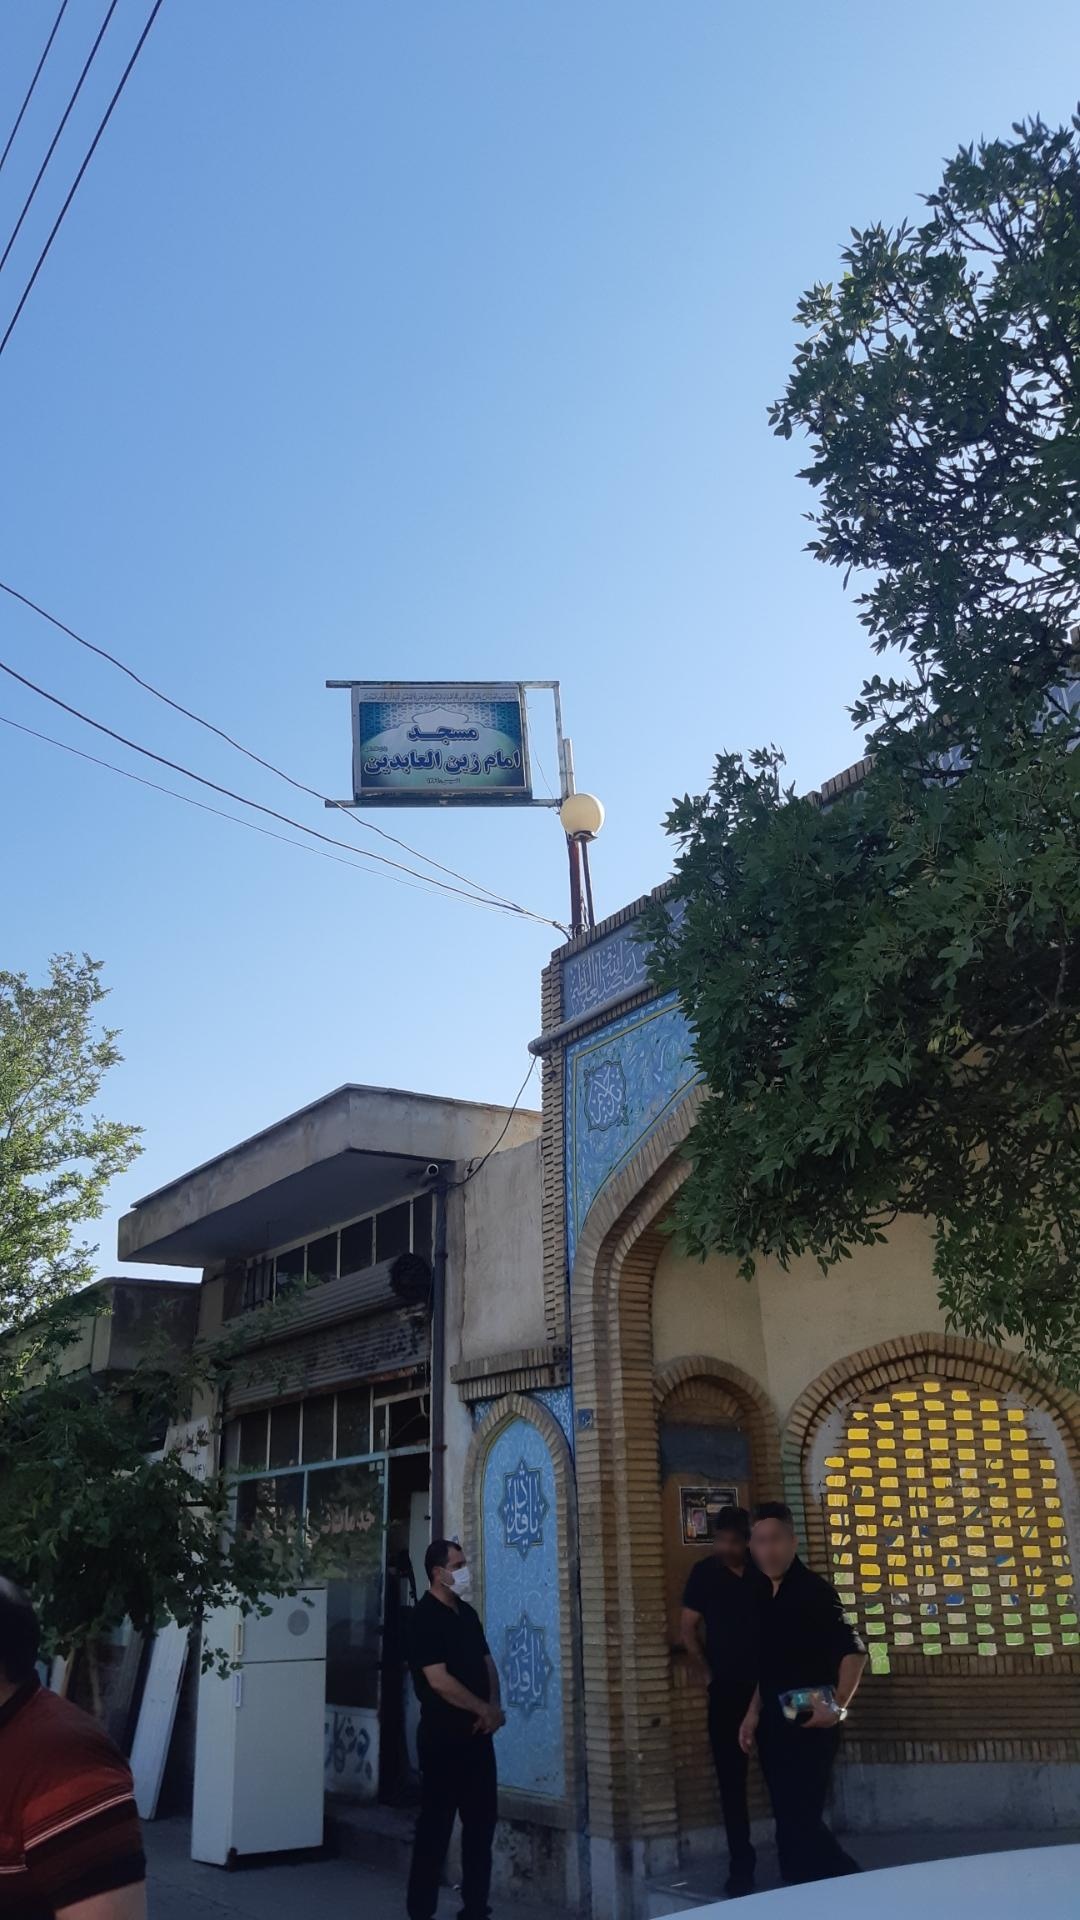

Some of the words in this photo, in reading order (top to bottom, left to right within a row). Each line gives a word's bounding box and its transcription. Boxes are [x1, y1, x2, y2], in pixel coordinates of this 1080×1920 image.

[407, 725, 479, 745] مسجد
[364, 750, 443, 775] العابدین
[444, 753, 482, 774] زین
[483, 750, 522, 774] امام
